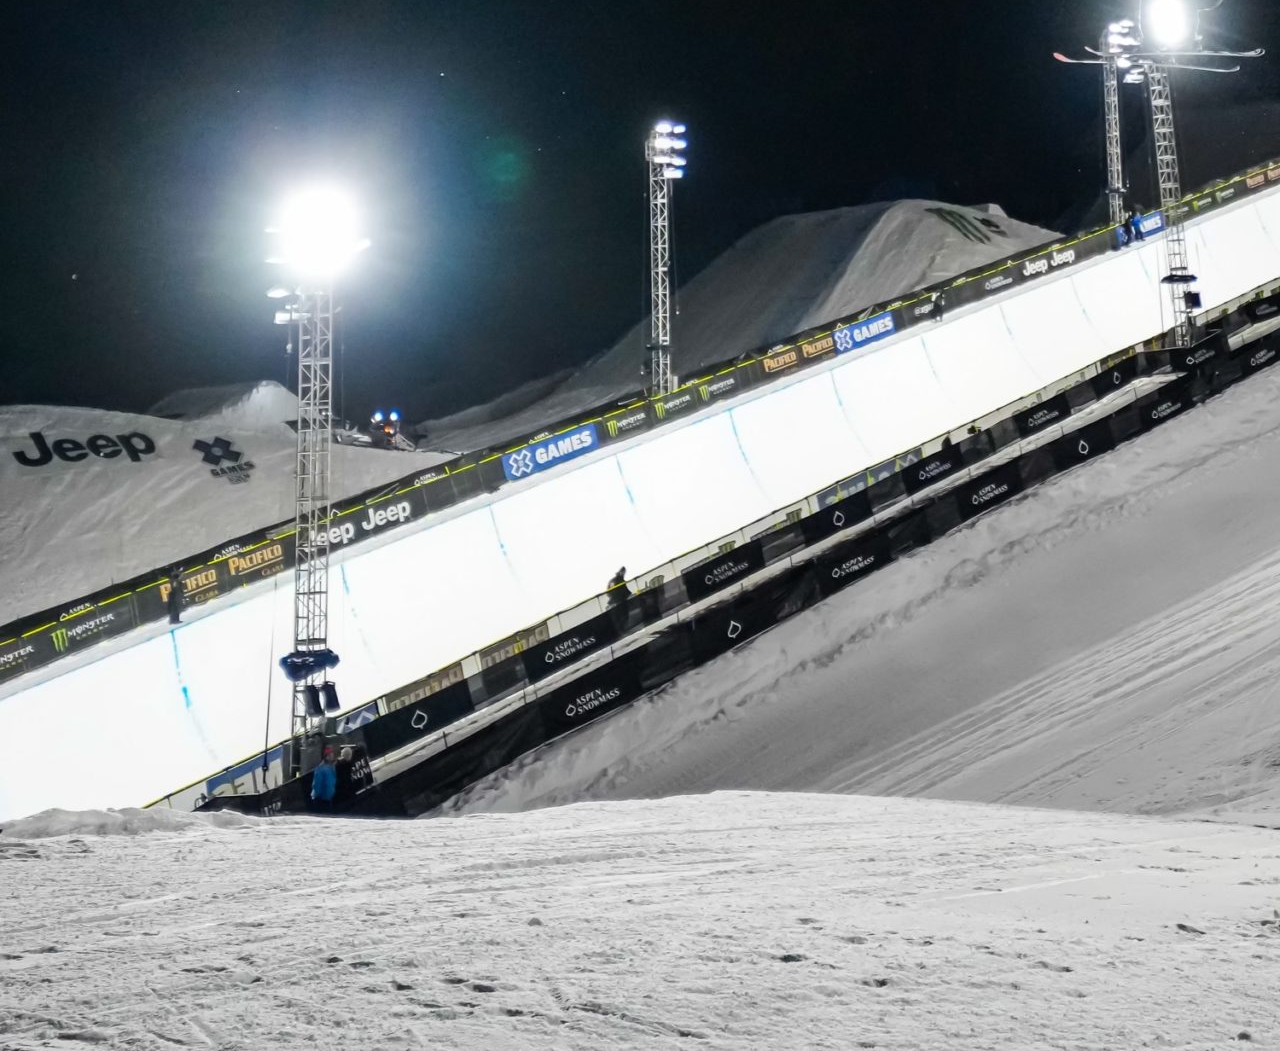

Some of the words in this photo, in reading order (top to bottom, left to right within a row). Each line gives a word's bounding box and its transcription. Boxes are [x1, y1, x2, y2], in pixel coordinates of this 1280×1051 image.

[1023, 259, 1049, 277] Jeep
[1050, 249, 1075, 267] Jeep
[853, 316, 893, 342] GAMES
[802, 336, 834, 358] PACIFICO
[763, 351, 797, 373] PACIFICO
[12, 431, 156, 468] Jeep
[535, 430, 592, 464] GAMES
[361, 501, 412, 531] Jeep
[228, 544, 283, 576] PACIFICO
[160, 570, 216, 603] PIFICO
[67, 613, 115, 638] MONSTER
[554, 637, 580, 653] ASPEN
[555, 635, 597, 661] SNOWMASS
[575, 688, 603, 705] ASPEN
[577, 687, 621, 715] SNOWMASS
